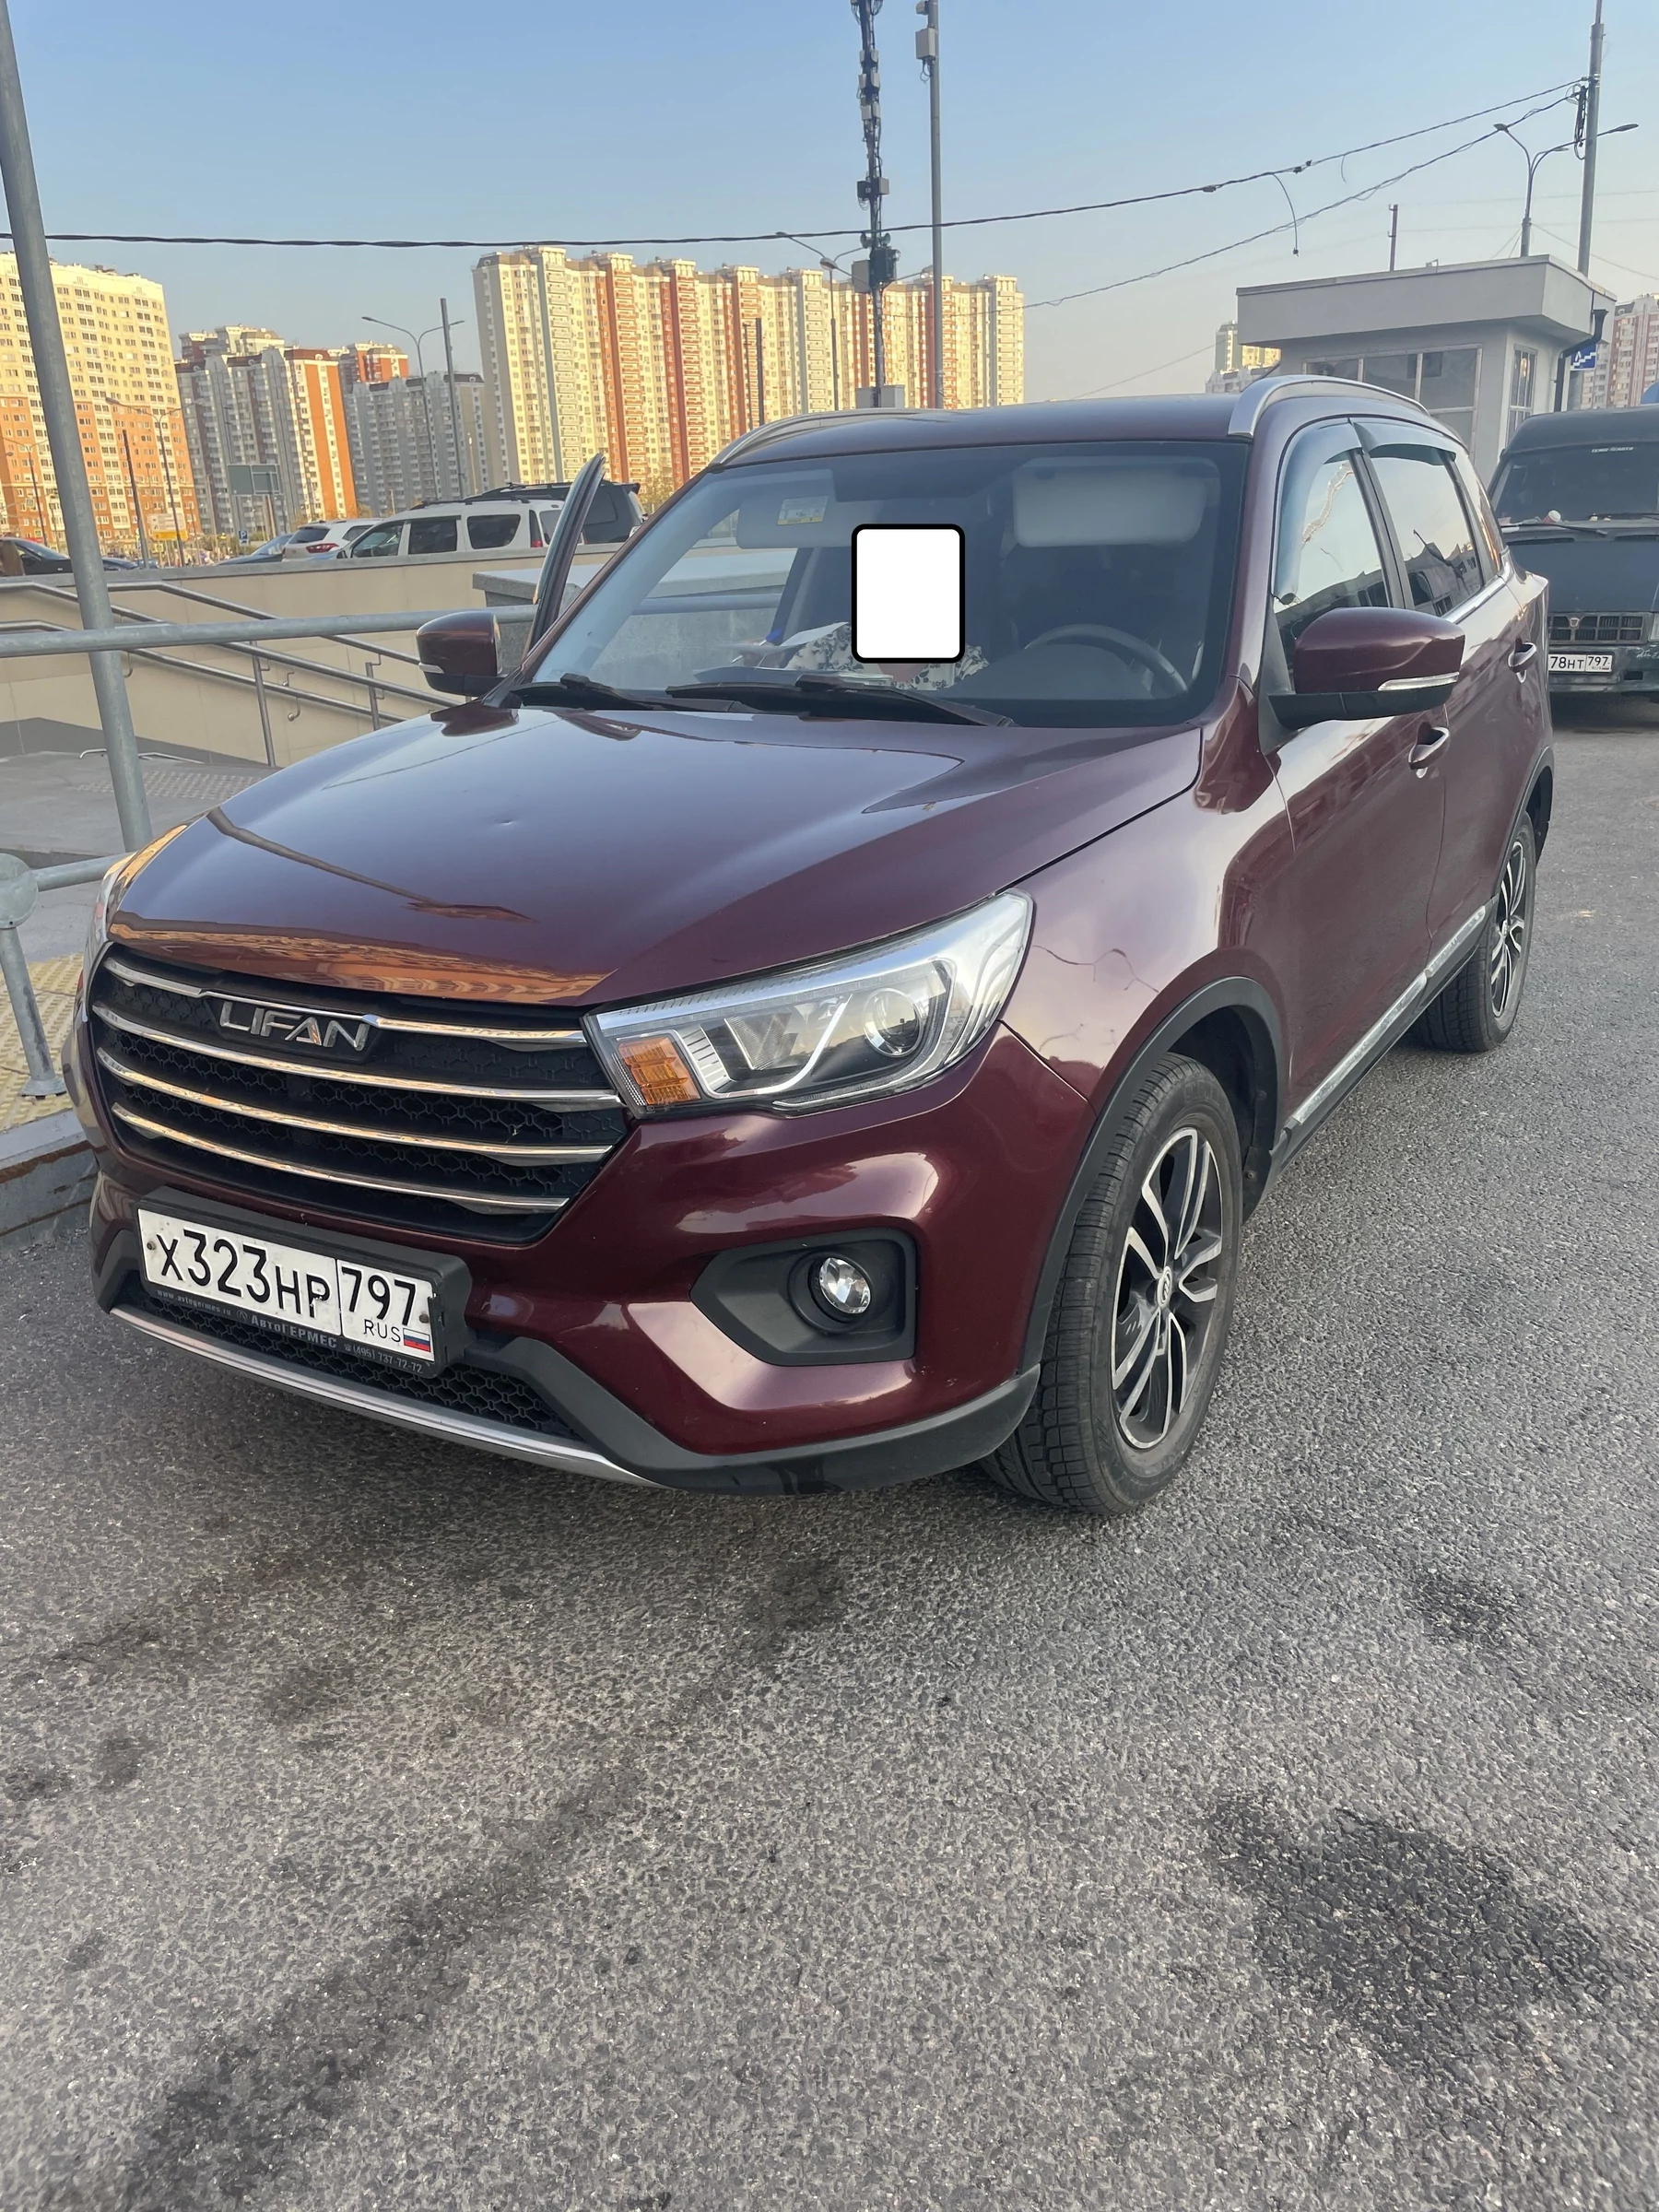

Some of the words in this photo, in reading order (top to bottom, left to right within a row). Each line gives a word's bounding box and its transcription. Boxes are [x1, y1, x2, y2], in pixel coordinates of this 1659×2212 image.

[1587, 656, 1609, 666] 797
[219, 1001, 370, 1052] LIFAN
[156, 1228, 330, 1319] Х323НР
[341, 1265, 417, 1326] 797
[157, 1289, 232, 1316] www.avtogermes.ru
[352, 1344, 376, 1359] (495)
[377, 1351, 424, 1374] 737-72-72
[363, 1319, 402, 1343] RUS
